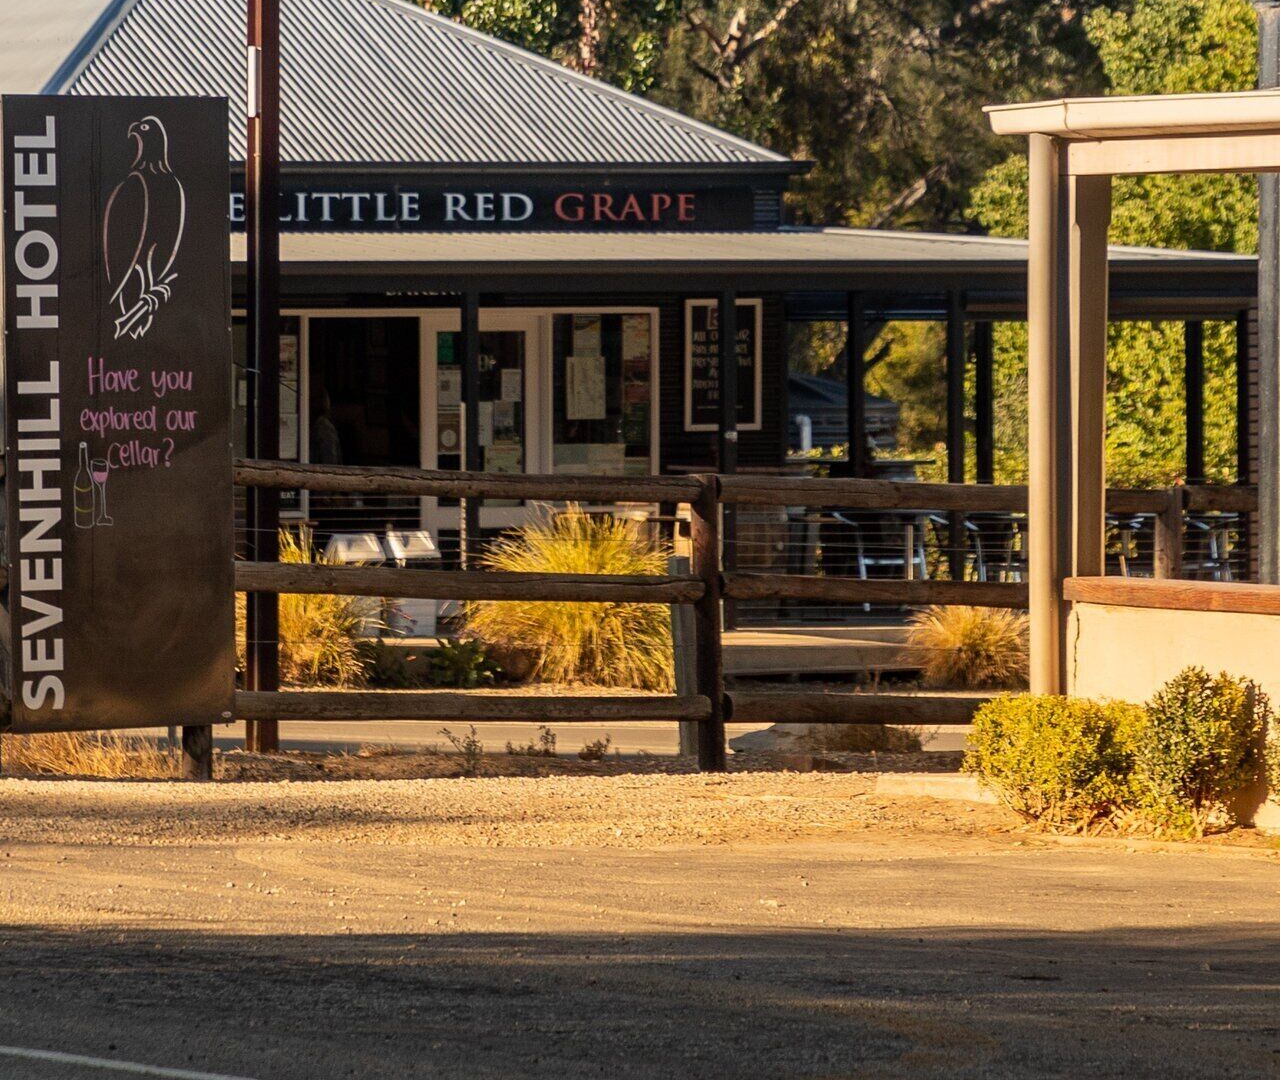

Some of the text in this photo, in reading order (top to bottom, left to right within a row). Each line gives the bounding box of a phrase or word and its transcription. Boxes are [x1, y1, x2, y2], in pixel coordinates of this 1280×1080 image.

[444, 192, 534, 223] RED
[554, 192, 697, 223] GRAPE
[87, 356, 193, 398] Have you
[14, 115, 65, 710] SEVENHILL HOTEL
[80, 405, 198, 438] explored our
